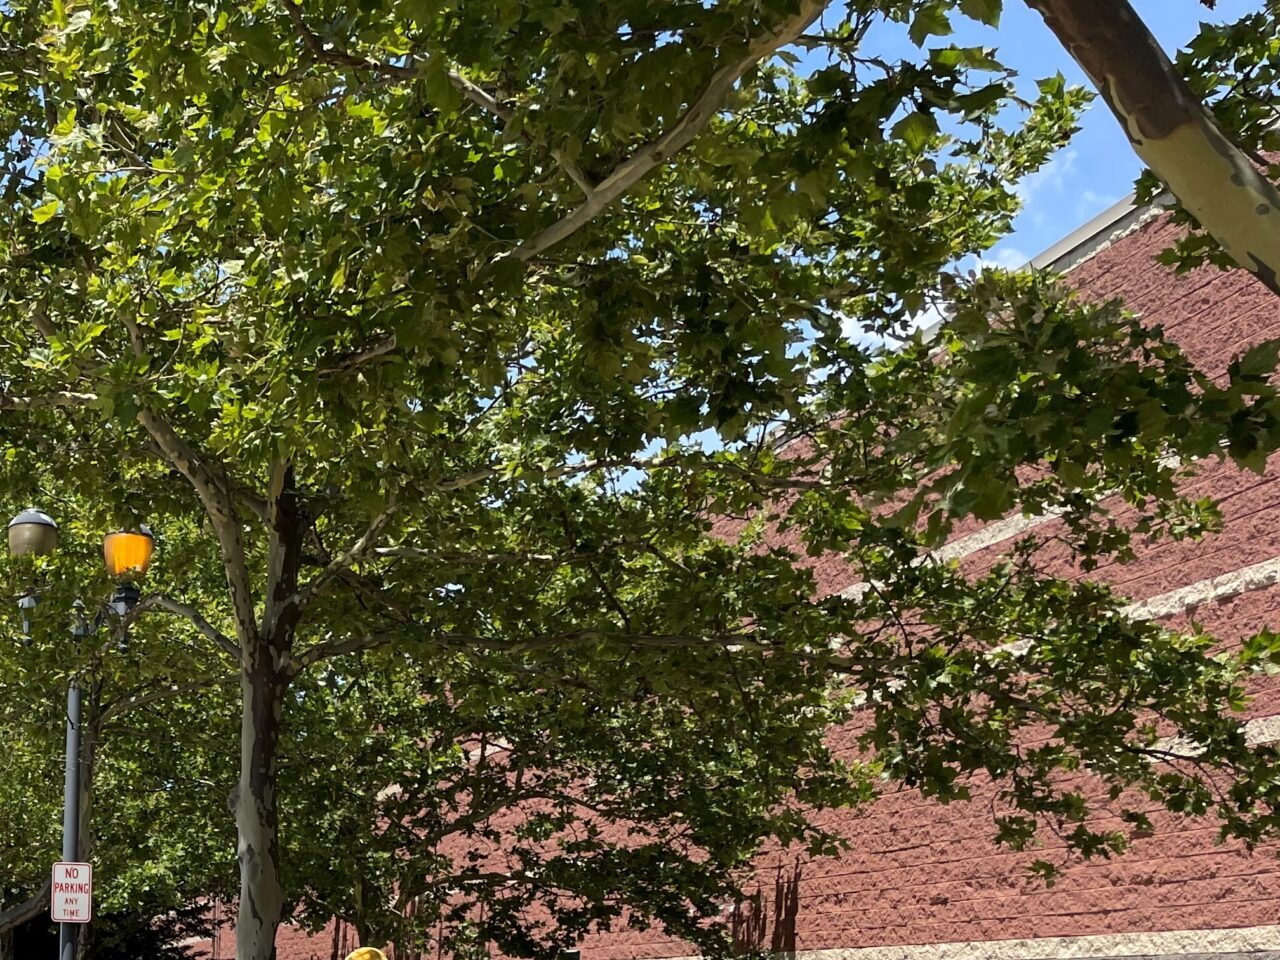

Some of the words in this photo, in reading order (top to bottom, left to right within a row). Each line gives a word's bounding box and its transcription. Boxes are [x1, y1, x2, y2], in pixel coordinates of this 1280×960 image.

[65, 867, 79, 879] NO
[54, 882, 89, 894] PARKING
[64, 897, 79, 905] ANY
[62, 908, 81, 917] TIME
